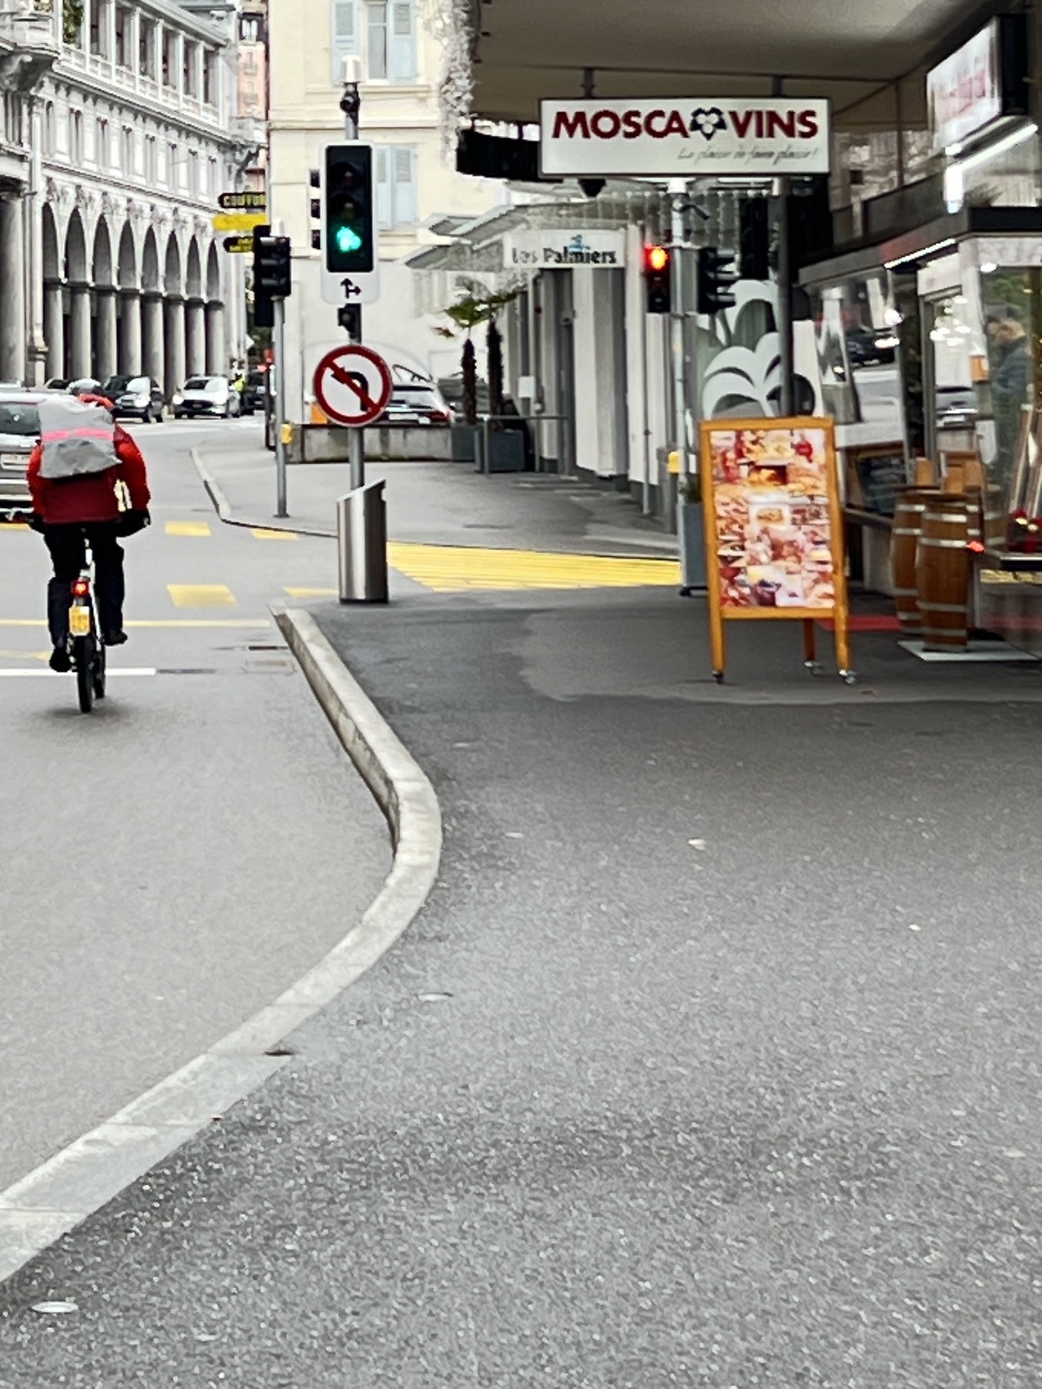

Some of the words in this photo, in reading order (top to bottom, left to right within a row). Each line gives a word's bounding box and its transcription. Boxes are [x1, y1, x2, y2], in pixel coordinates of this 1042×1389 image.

[552, 110, 690, 139] MOSCA
[727, 110, 819, 139] VINS
[542, 245, 617, 264] Palmiers
